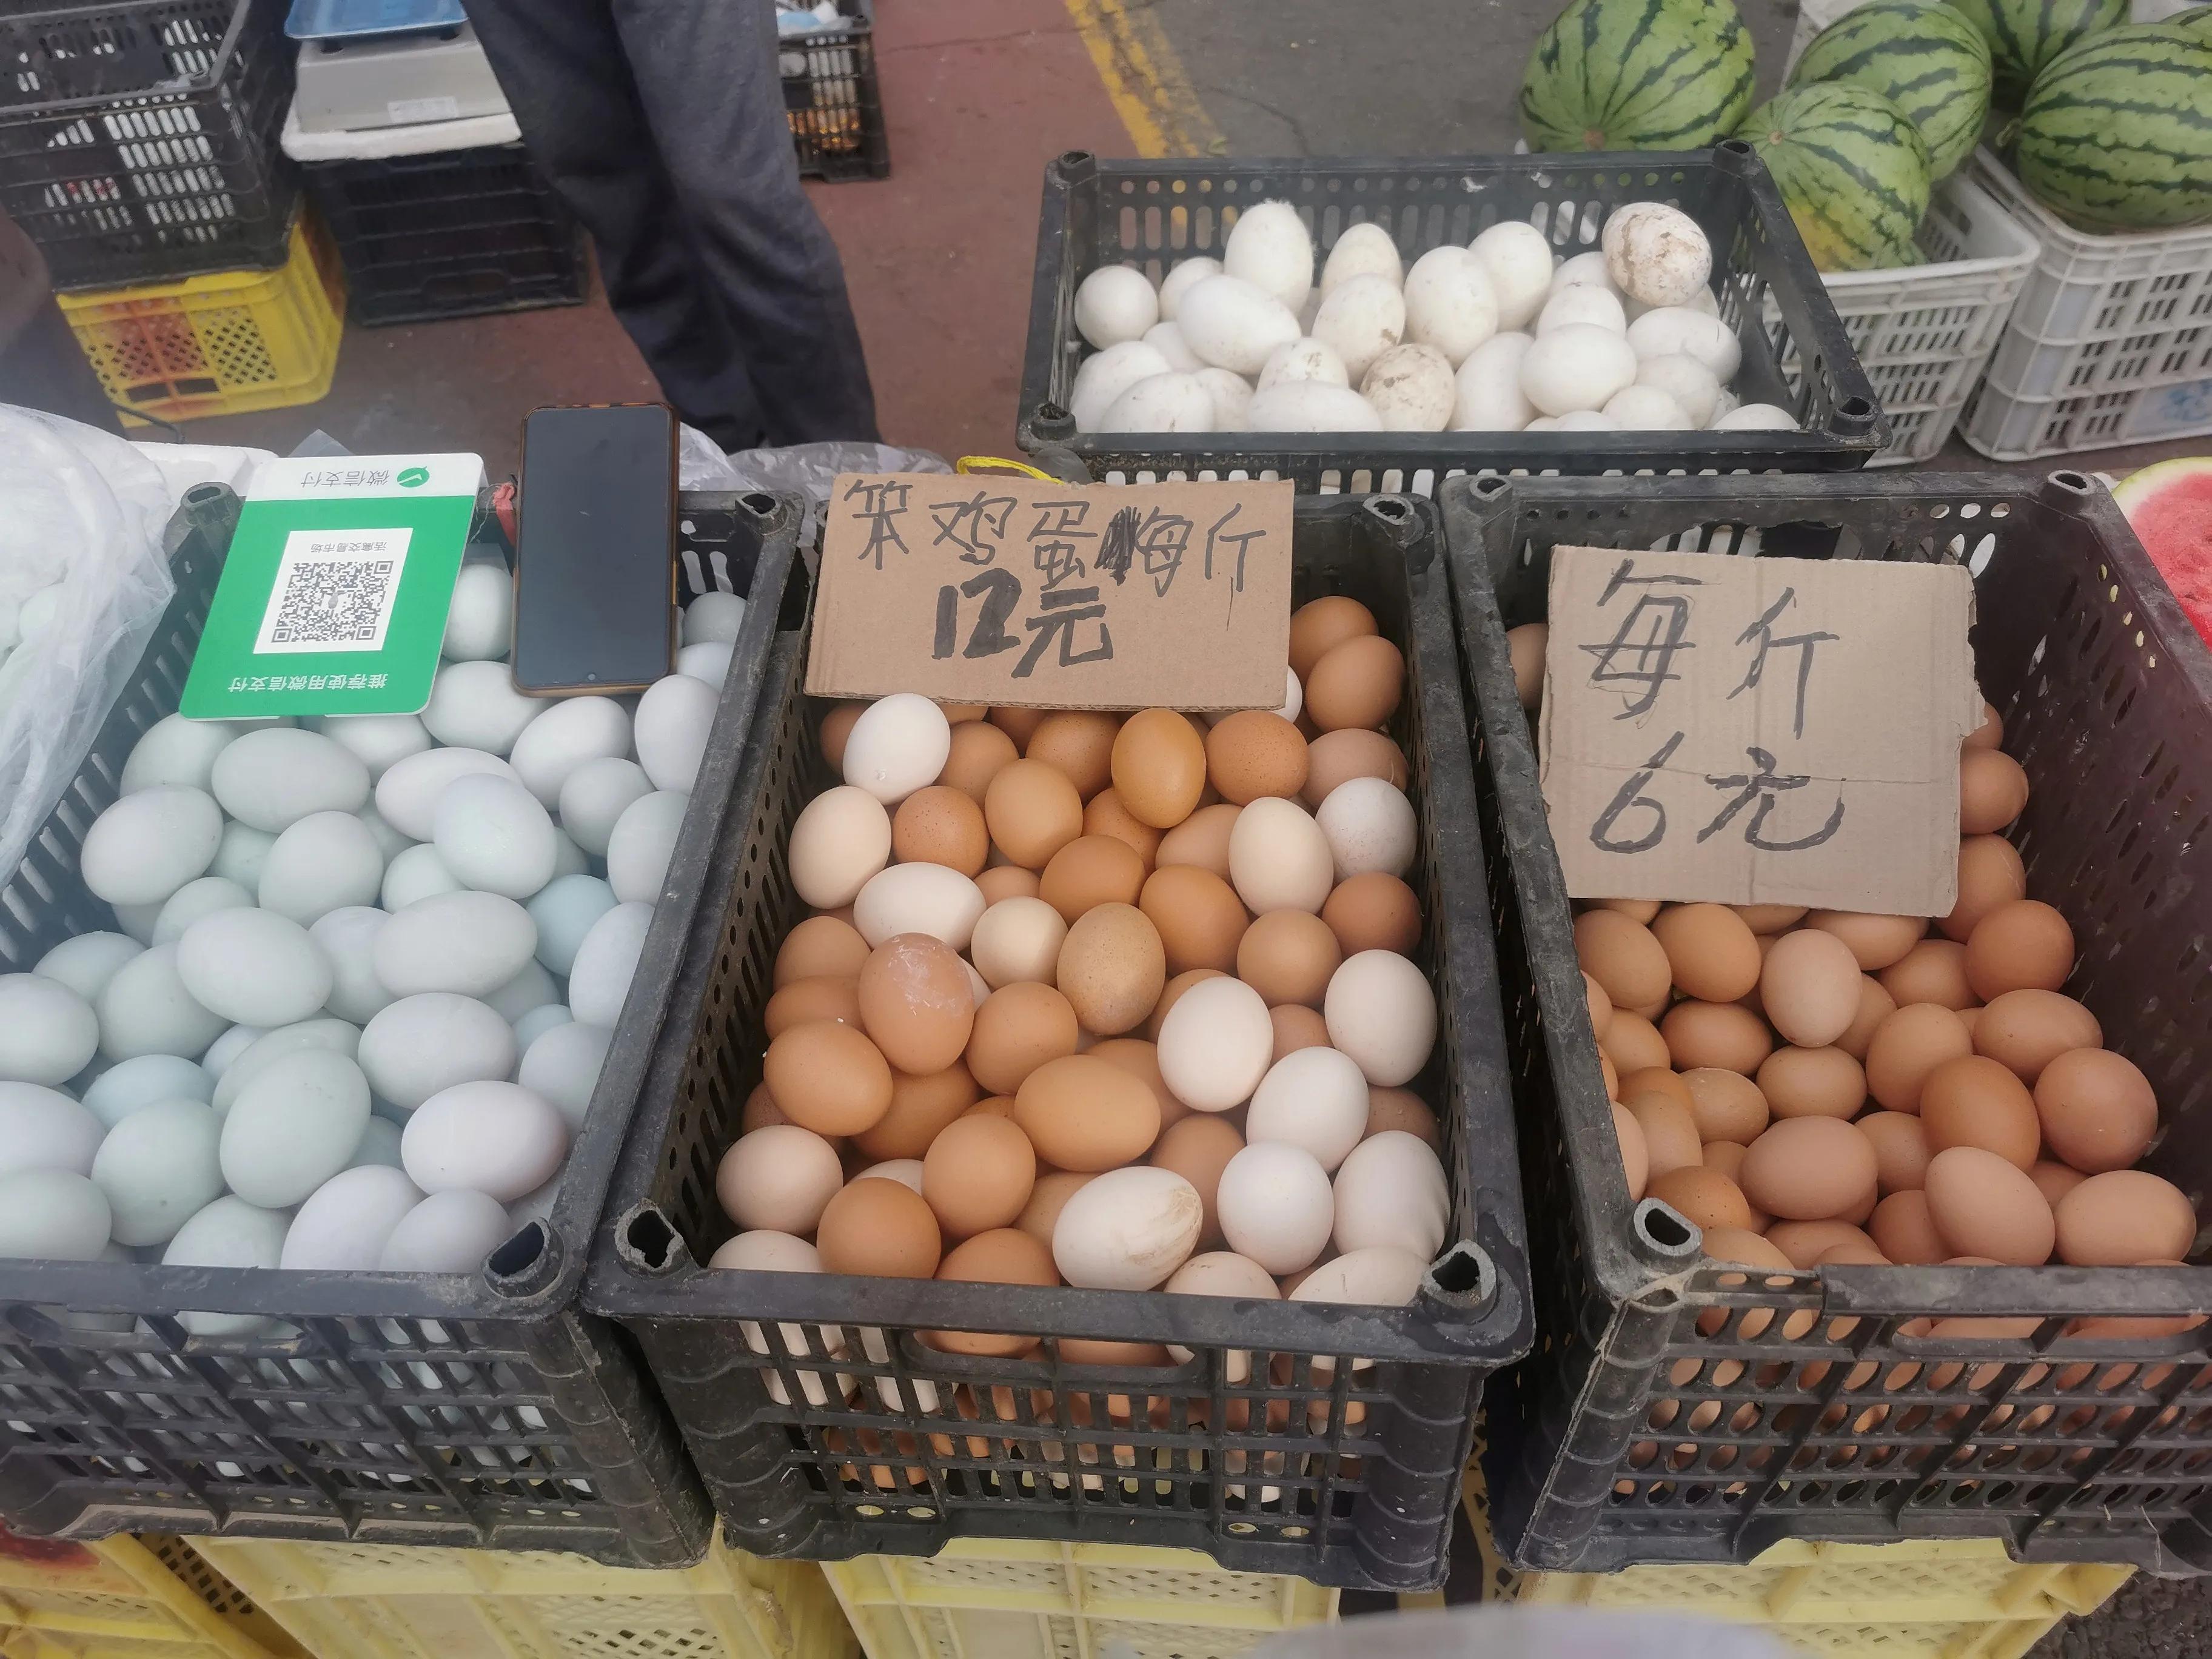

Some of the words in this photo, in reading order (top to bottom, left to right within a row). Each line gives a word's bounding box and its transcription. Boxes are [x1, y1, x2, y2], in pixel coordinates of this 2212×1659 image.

[301, 470, 390, 488] 微信支付
[932, 568, 1114, 678] 12元
[1578, 558, 1840, 740] 每斤
[229, 674, 388, 692] 推荐使用微信支付
[1590, 731, 1846, 853] 6元
